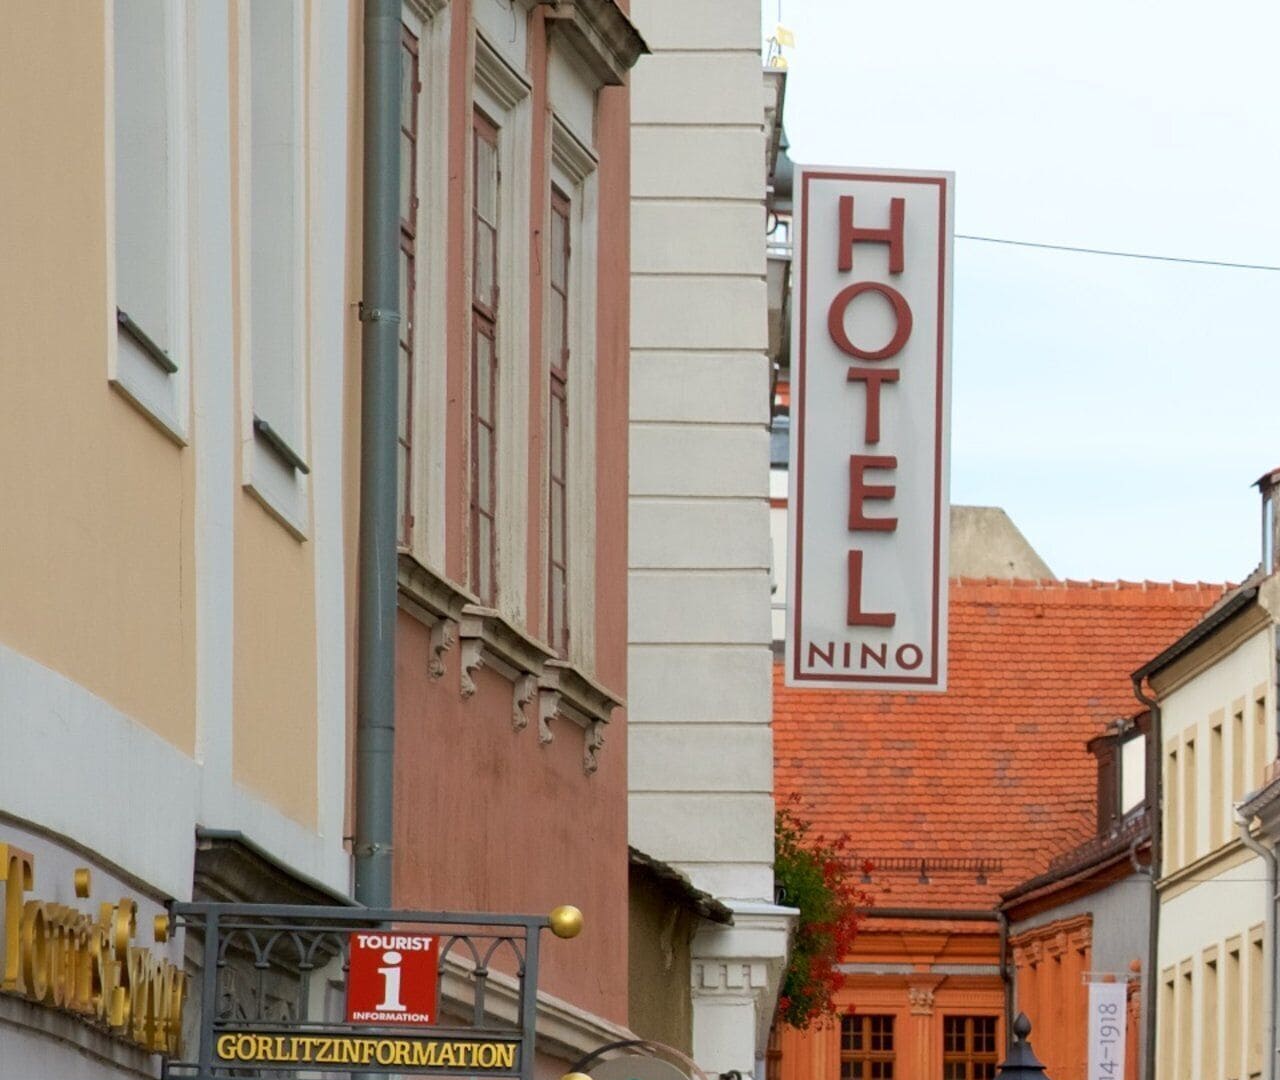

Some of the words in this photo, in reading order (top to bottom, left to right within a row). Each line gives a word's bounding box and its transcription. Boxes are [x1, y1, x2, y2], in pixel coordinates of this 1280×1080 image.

[828, 195, 913, 628] HOTEL
[807, 642, 923, 672] NINO
[357, 935, 432, 950] TOURIST
[352, 1011, 429, 1023] INFORMATION
[216, 1032, 516, 1068] GÖRLITZINFORMATION
